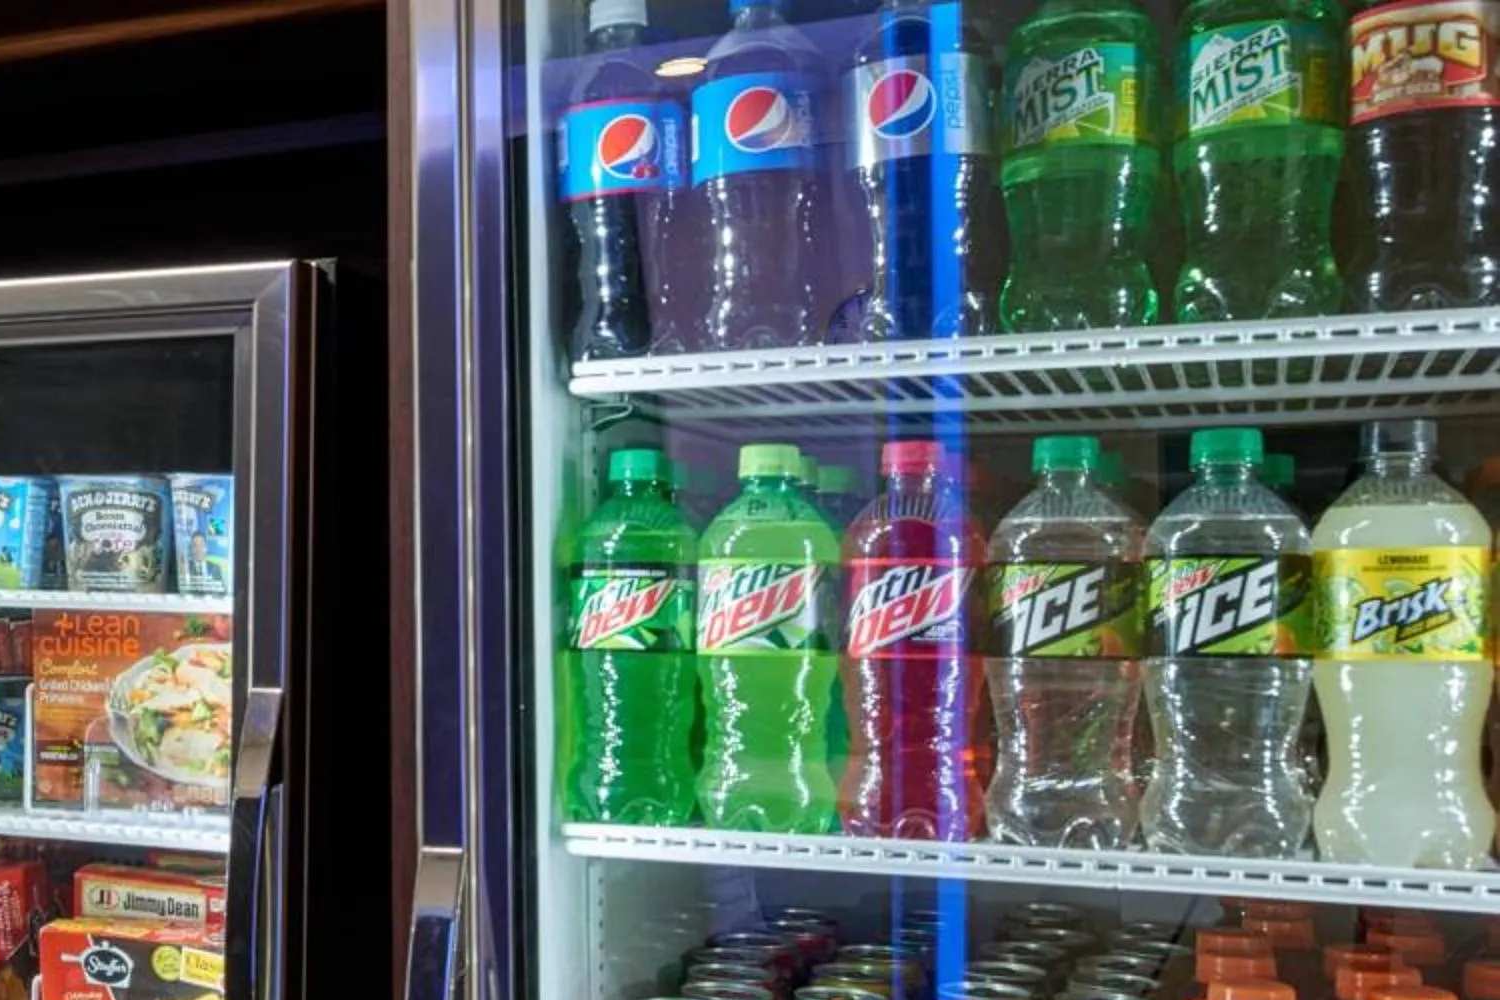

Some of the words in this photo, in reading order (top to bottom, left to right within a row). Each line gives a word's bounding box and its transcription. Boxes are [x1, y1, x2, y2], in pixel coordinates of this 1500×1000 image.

[1191, 26, 1287, 91] SIERRA
[1191, 41, 1291, 125] MIST
[1351, 22, 1481, 87] MUG
[1013, 62, 1103, 139] MIST
[74, 614, 141, 637] Lean
[1011, 565, 1106, 657] ICE
[1177, 559, 1278, 653] ICE
[1352, 577, 1455, 641] Brisk
[123, 890, 167, 917] Jimmy
[167, 896, 207, 919] Dean
